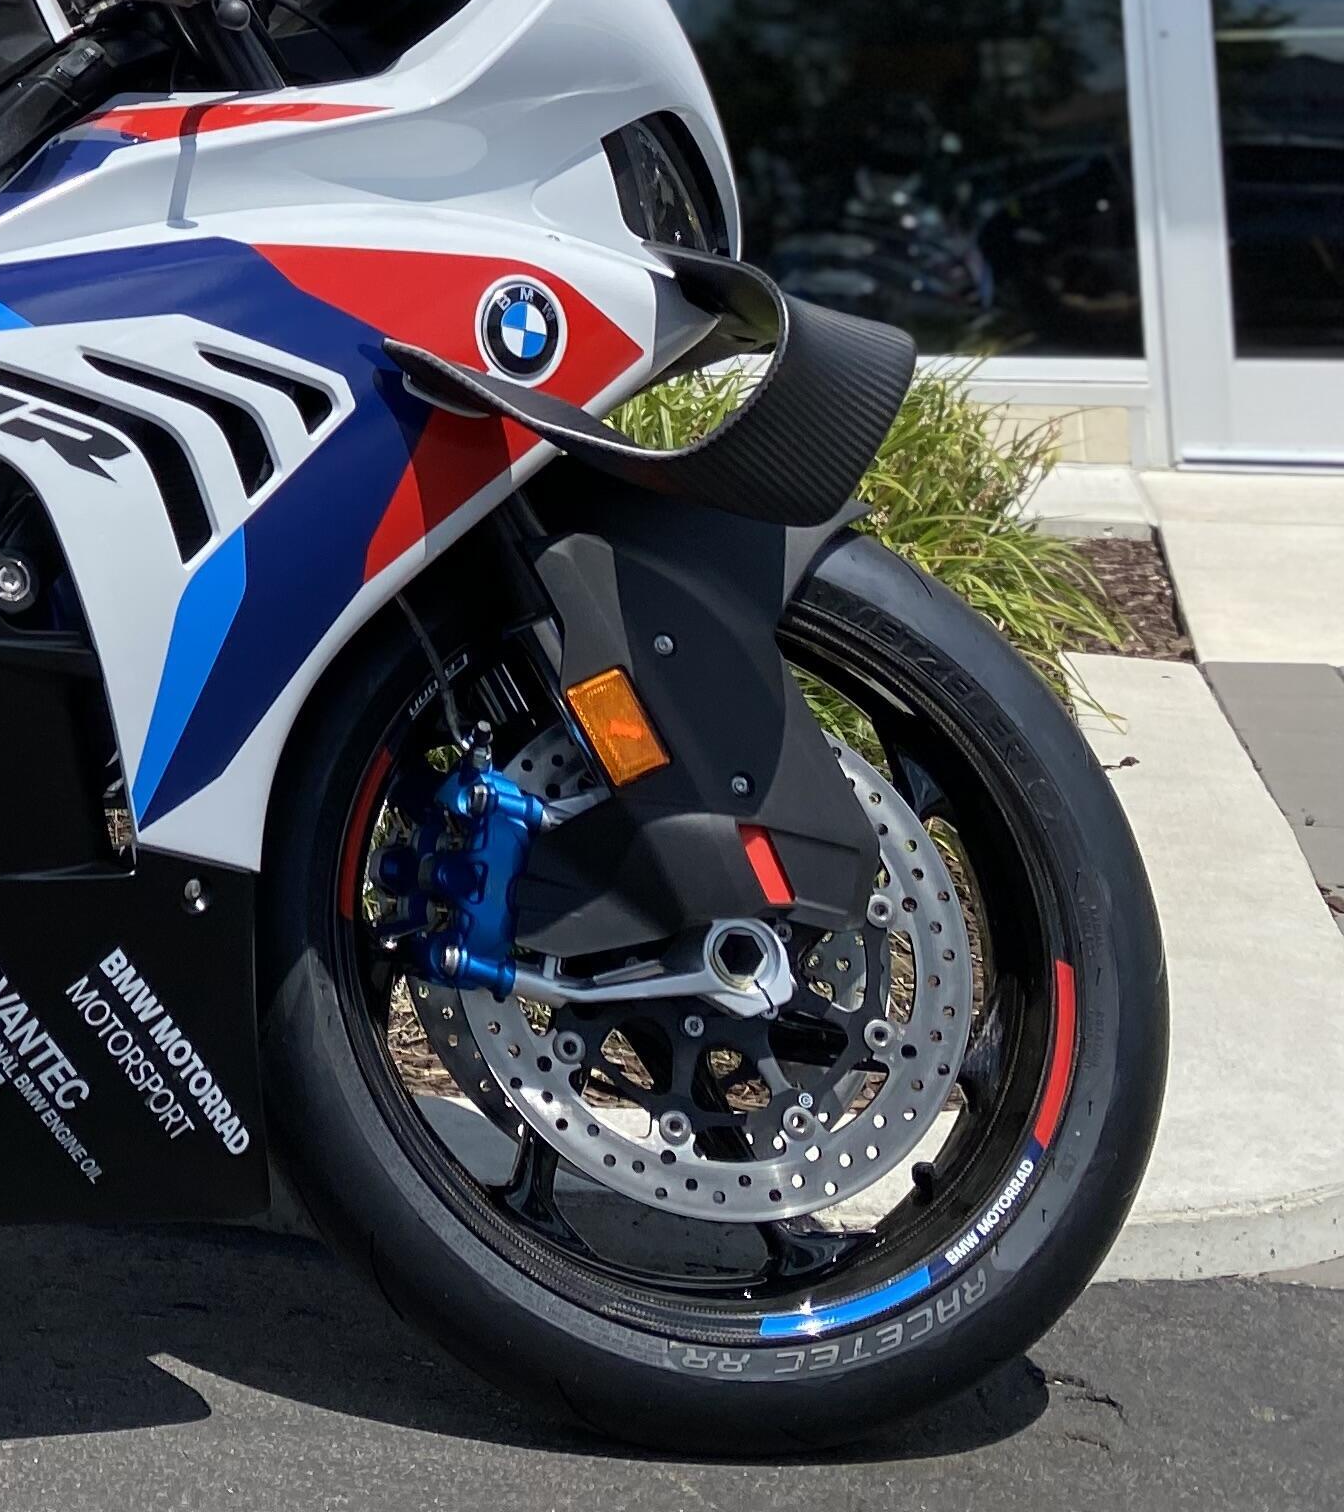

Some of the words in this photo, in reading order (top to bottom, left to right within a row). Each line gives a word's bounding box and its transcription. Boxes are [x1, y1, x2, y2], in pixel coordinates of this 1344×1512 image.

[495, 287, 556, 322] BMW
[65, 976, 195, 1140] MOTORSPORT
[99, 947, 163, 1024] BMW
[150, 1016, 250, 1156] MOTORRAD
[13, 1074, 50, 1113] BMW
[40, 1107, 88, 1164] ENGINE
[80, 1158, 103, 1185] OIL
[944, 1229, 980, 1266] BMW
[976, 1159, 1034, 1236] MOTORRAD
[681, 1347, 752, 1374] RR
[774, 1268, 988, 1374] RACETEC
